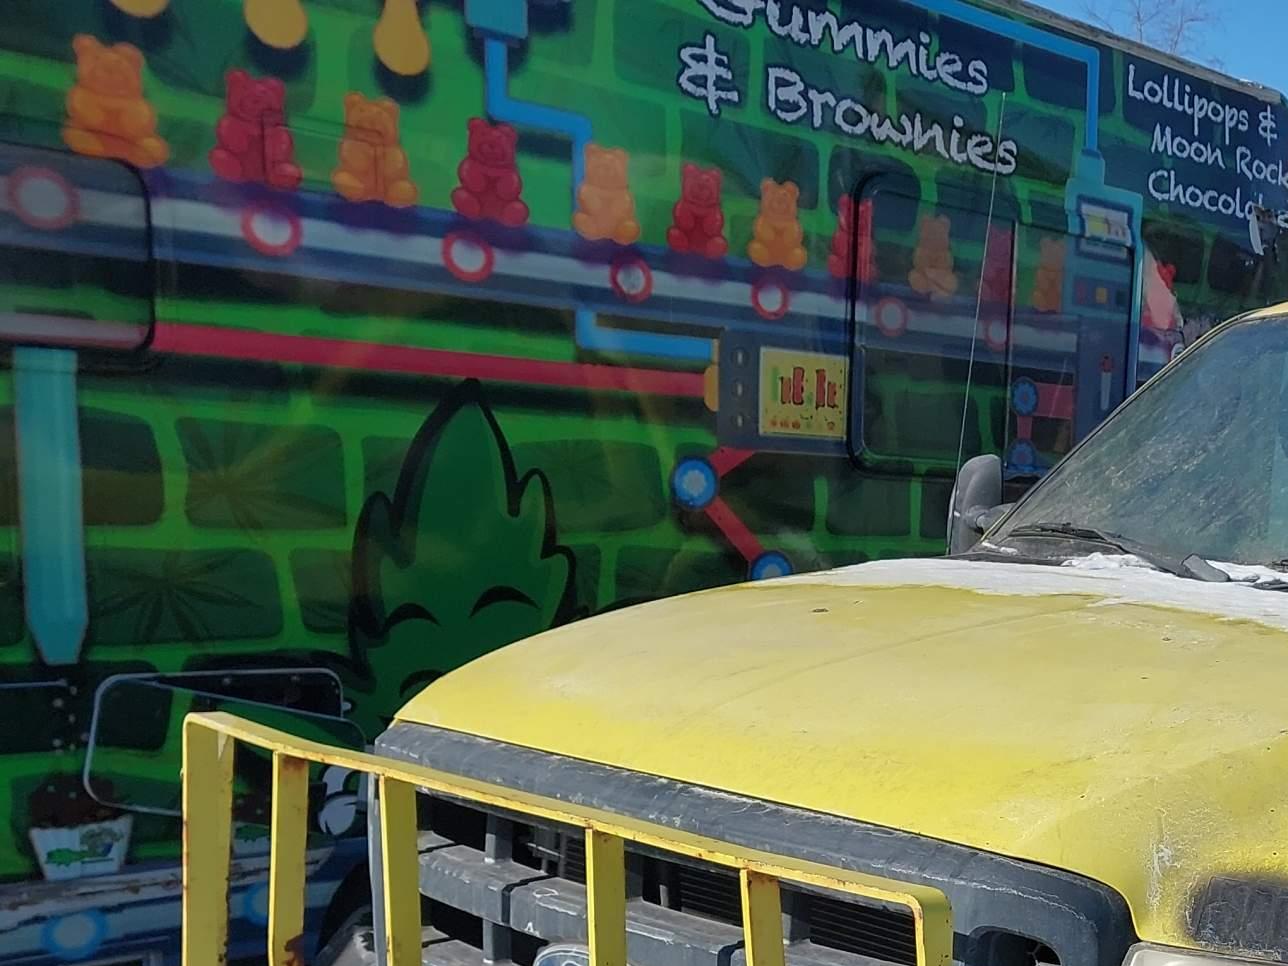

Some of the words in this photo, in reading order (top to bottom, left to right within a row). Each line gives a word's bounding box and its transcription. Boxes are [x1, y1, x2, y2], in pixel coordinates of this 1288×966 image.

[677, 34, 740, 116] &
[767, 66, 1018, 175] Brownies
[1127, 63, 1250, 146] Lollipops
[1258, 104, 1278, 146] &
[1151, 122, 1226, 169] Moon
